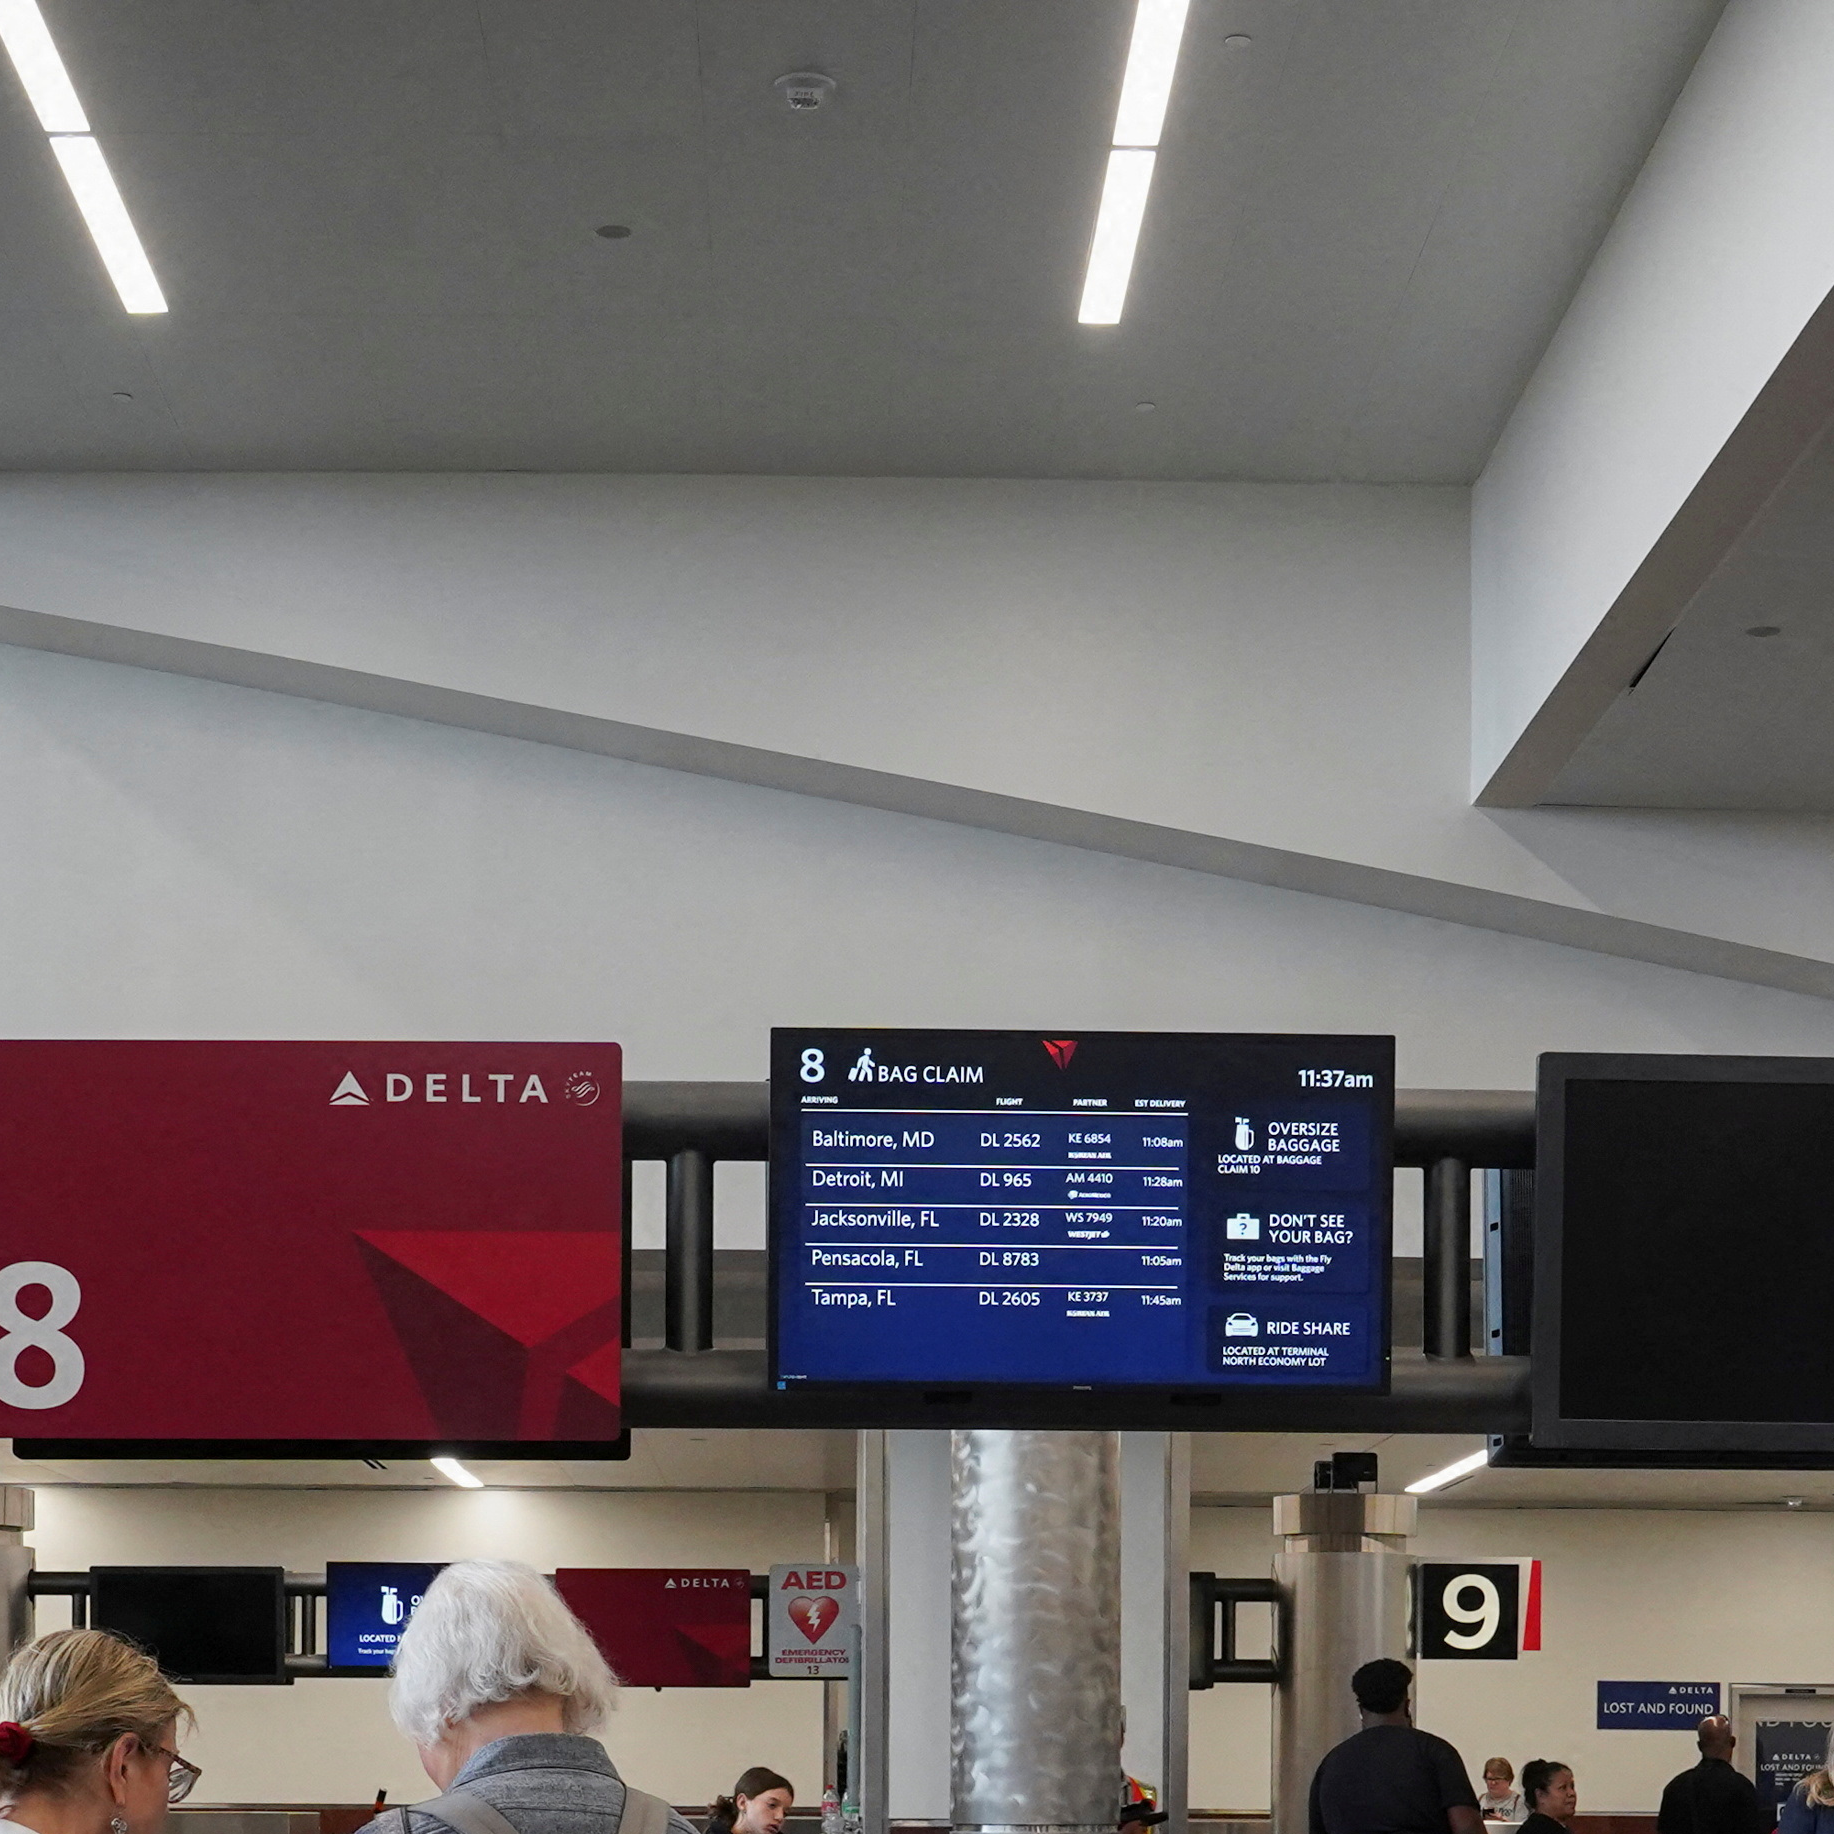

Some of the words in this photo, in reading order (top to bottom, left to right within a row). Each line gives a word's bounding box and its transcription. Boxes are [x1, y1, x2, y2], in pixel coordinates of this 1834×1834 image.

[799, 1047, 826, 1084] 8
[877, 1065, 918, 1084] BAG
[922, 1065, 985, 1084] CLAIM
[1298, 1069, 1374, 1088] 11:37am
[386, 1073, 549, 1104] DELTA
[995, 1097, 1024, 1106] FLIGHT
[1072, 1098, 1108, 1107] PARTNER
[1149, 1099, 1186, 1108] DELIVERY
[1268, 1121, 1339, 1136] OVERSIZE
[812, 1130, 898, 1150] Baltimore,
[902, 1130, 935, 1148] MD
[980, 1132, 1000, 1148] DL
[1003, 1132, 1041, 1148] 2562
[1068, 1133, 1082, 1144] KE
[1084, 1133, 1112, 1144] 6854
[1142, 1136, 1184, 1148] 11:08am
[1268, 1138, 1341, 1152] BAGGAGE
[1218, 1154, 1261, 1164] LOCATED
[1262, 1155, 1275, 1164] AT
[1276, 1155, 1323, 1165] BAGGAGE
[1217, 1164, 1248, 1175] CLAIM
[812, 1170, 876, 1190] Detroit,
[880, 1170, 904, 1188] MI
[980, 1172, 1000, 1187] DL
[1002, 1172, 1032, 1187] 965
[1065, 1173, 1085, 1184] AM
[1087, 1173, 1113, 1184] 4410
[1142, 1176, 1183, 1188] 11:28am
[811, 1209, 916, 1229] Jacksonville,
[919, 1210, 940, 1228] FL
[979, 1212, 1000, 1227] DL
[1003, 1212, 1040, 1227] 2328
[1065, 1212, 1084, 1223] WS
[1086, 1213, 1113, 1223] 7949
[1142, 1216, 1183, 1227] 11:20am
[1269, 1213, 1317, 1228] DON'T
[1320, 1214, 1345, 1228] SEE
[1268, 1230, 1312, 1244] YOUR
[1314, 1230, 1354, 1244] BAG?
[811, 1249, 900, 1269] Pensacola,
[904, 1250, 924, 1267] FL
[979, 1251, 999, 1266] DL
[1002, 1251, 1040, 1266] 8783
[1141, 1255, 1182, 1267] 11:05am
[1223, 1253, 1246, 1263] Track
[1247, 1255, 1266, 1264] your
[1266, 1254, 1285, 1264] bags
[1286, 1254, 1304, 1263] with
[1223, 1263, 1246, 1272] Delta
[1223, 1273, 1257, 1282] Services
[1270, 1274, 1304, 1283] support.
[811, 1289, 873, 1309] Tampa,
[876, 1289, 897, 1306] FL
[978, 1291, 999, 1306] DL
[1002, 1291, 1041, 1306] 2605
[1067, 1291, 1081, 1302] KE
[1083, 1291, 1109, 1302] 3737
[1141, 1295, 1182, 1306] 11:45am
[1267, 1321, 1300, 1336] RIDE
[1302, 1322, 1351, 1336] SHARE
[1222, 1346, 1266, 1356] LOCATED
[1267, 1347, 1280, 1356] AT
[1281, 1347, 1330, 1357] TERMINAL
[1222, 1356, 1256, 1366] NORTH
[1258, 1357, 1307, 1366] ECONOMY
[1308, 1357, 1327, 1367] LOT
[680, 1577, 730, 1588] DELTA
[780, 1570, 847, 1590] AED
[1441, 1573, 1501, 1651] 9
[359, 1634, 396, 1643] LOCATED
[781, 1648, 847, 1657] EMERGENCY
[806, 1665, 820, 1675] 13
[1679, 1686, 1714, 1694] DELTA
[1603, 1701, 1635, 1715] LOST
[1637, 1702, 1666, 1715] AND
[1669, 1702, 1714, 1715] FOUND
[1781, 1753, 1812, 1761] DELTA
[1760, 1763, 1780, 1772] LOST
[1781, 1763, 1801, 1772] AND
